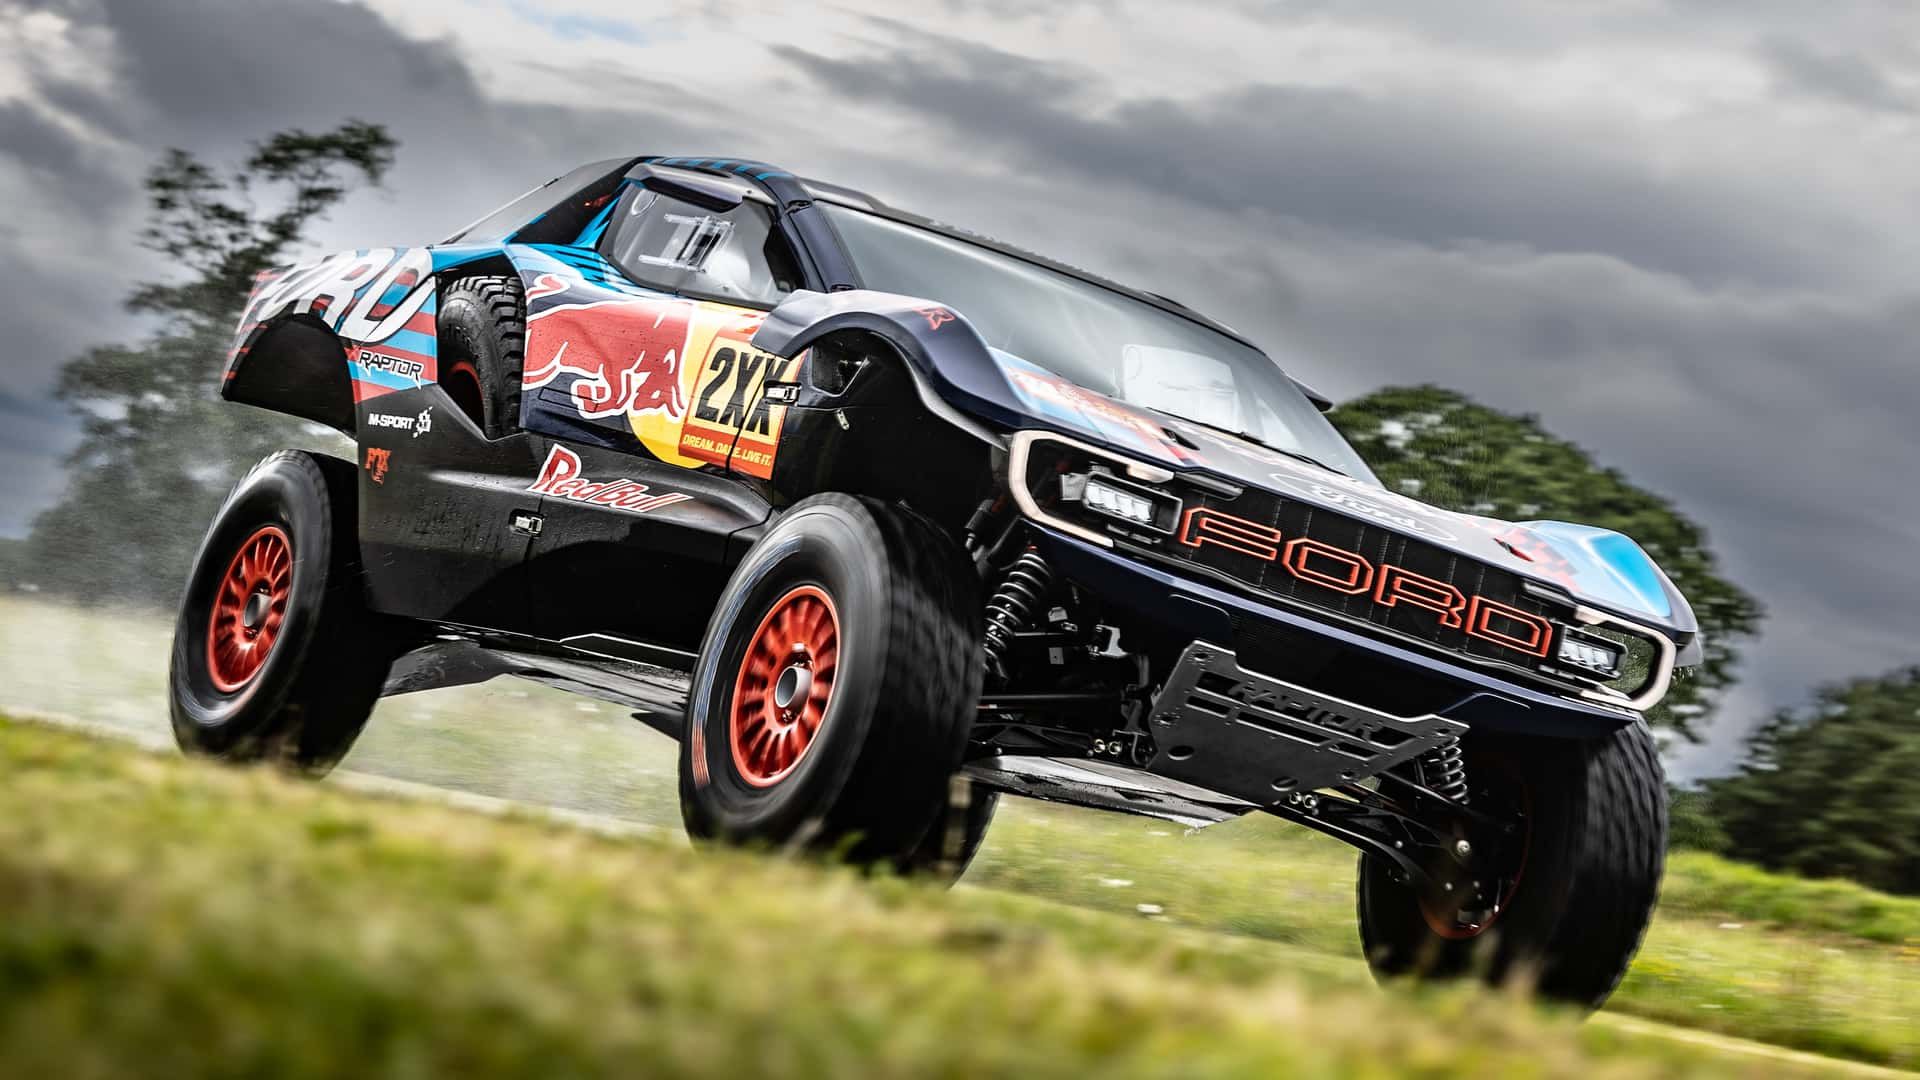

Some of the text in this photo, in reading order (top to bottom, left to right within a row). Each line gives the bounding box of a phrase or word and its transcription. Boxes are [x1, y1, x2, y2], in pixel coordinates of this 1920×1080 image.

[359, 351, 423, 389] RAPTOR
[368, 412, 415, 431] M-SPORT
[1178, 506, 1553, 658] FORD
[1227, 680, 1384, 742] RAPTOR
